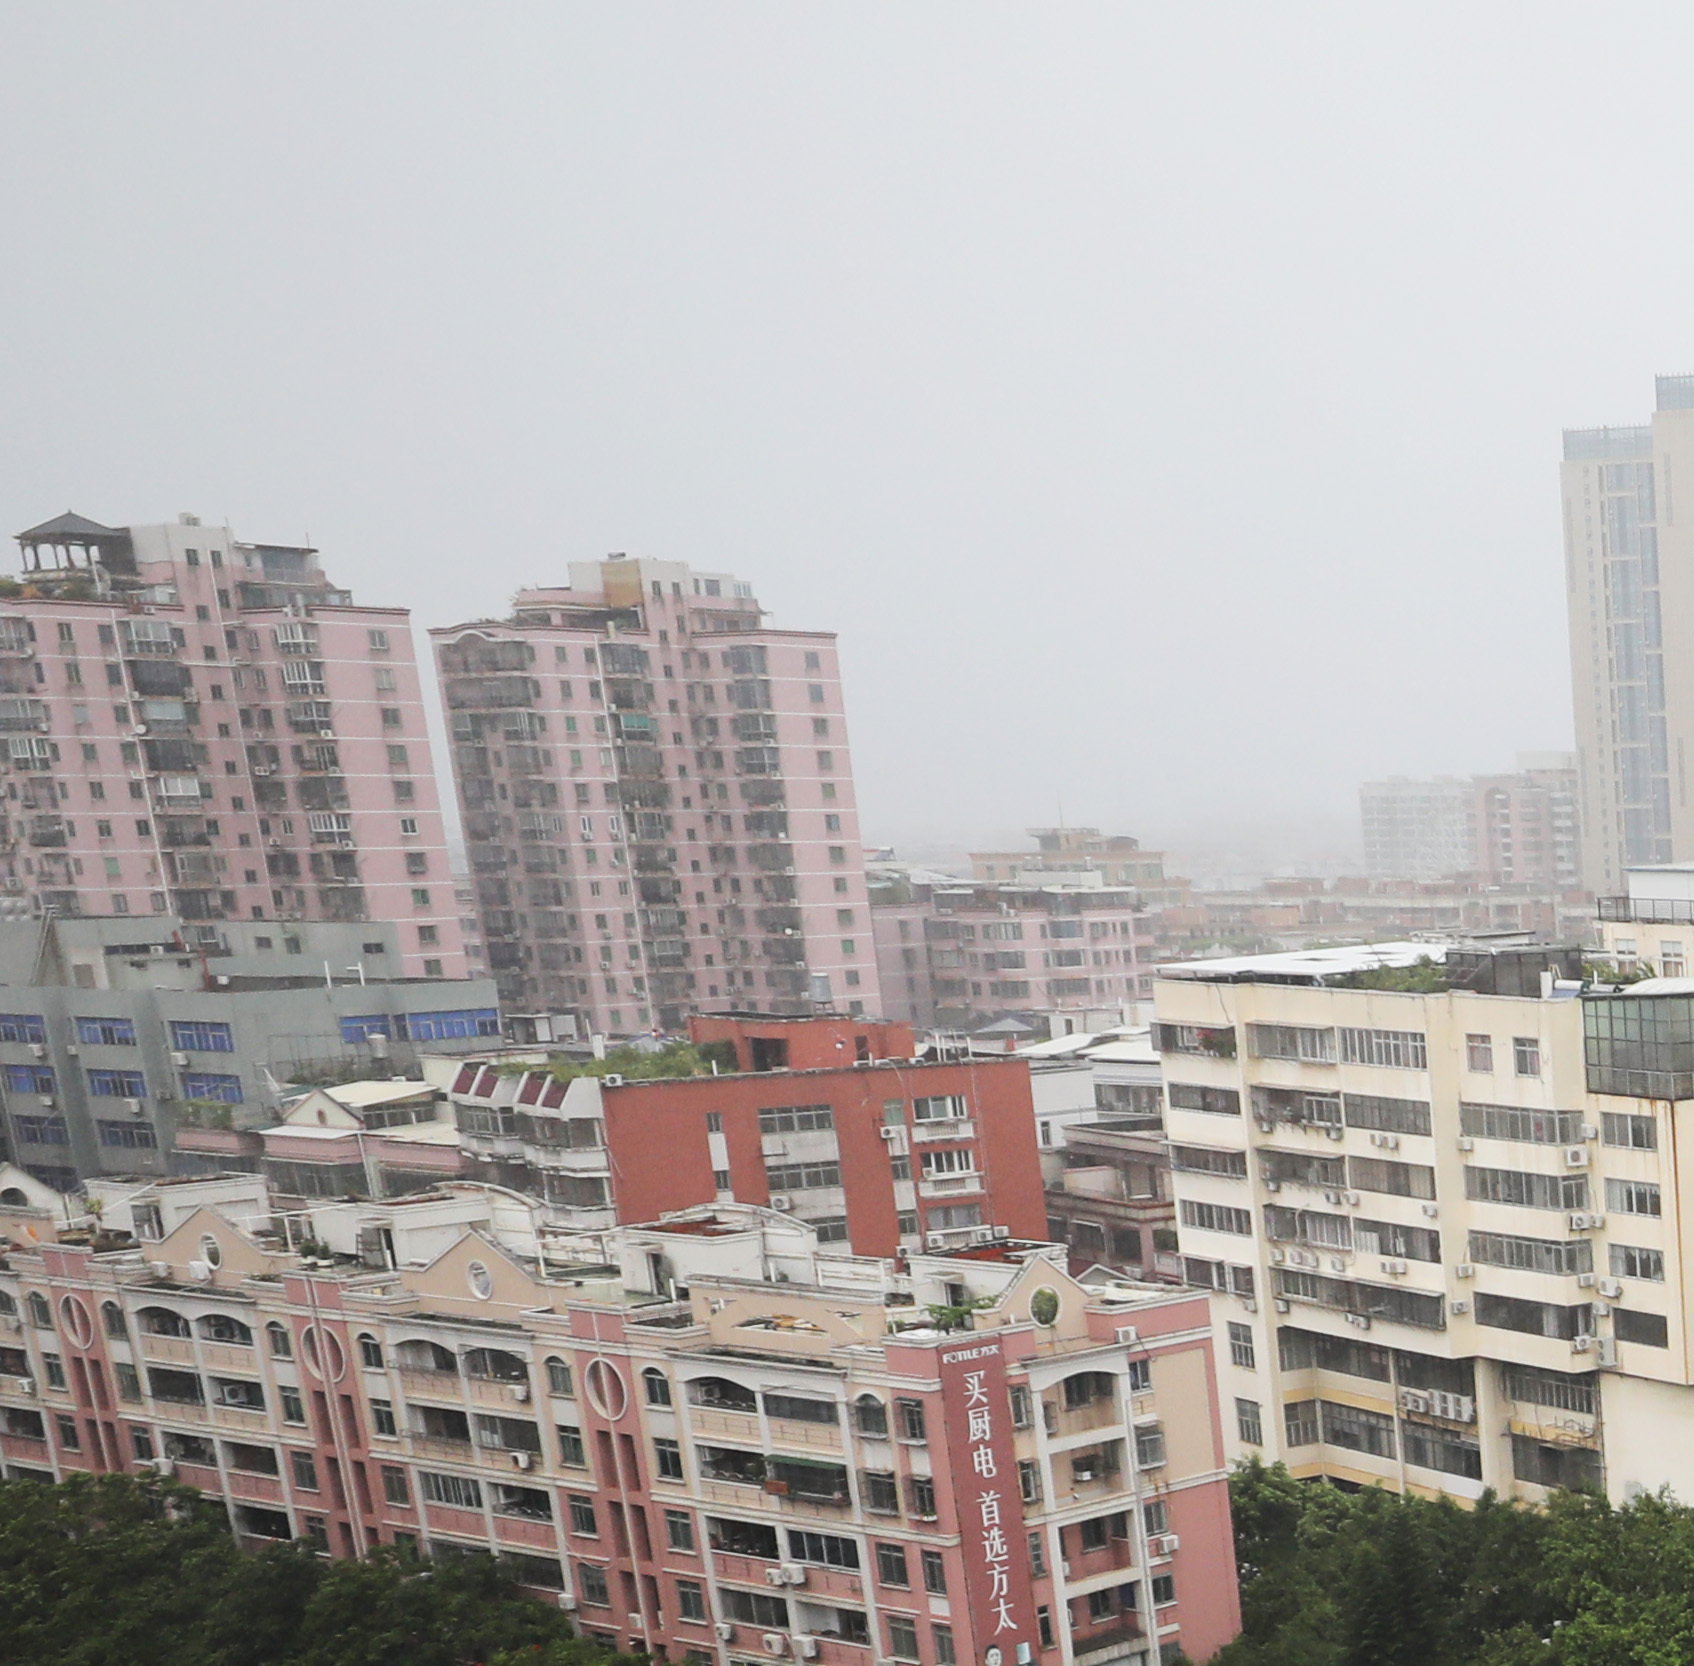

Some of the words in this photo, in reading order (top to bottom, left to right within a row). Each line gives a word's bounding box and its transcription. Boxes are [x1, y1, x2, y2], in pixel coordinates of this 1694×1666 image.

[962, 1369, 998, 1479] 买厨电
[975, 1489, 1018, 1636] 首选方太
